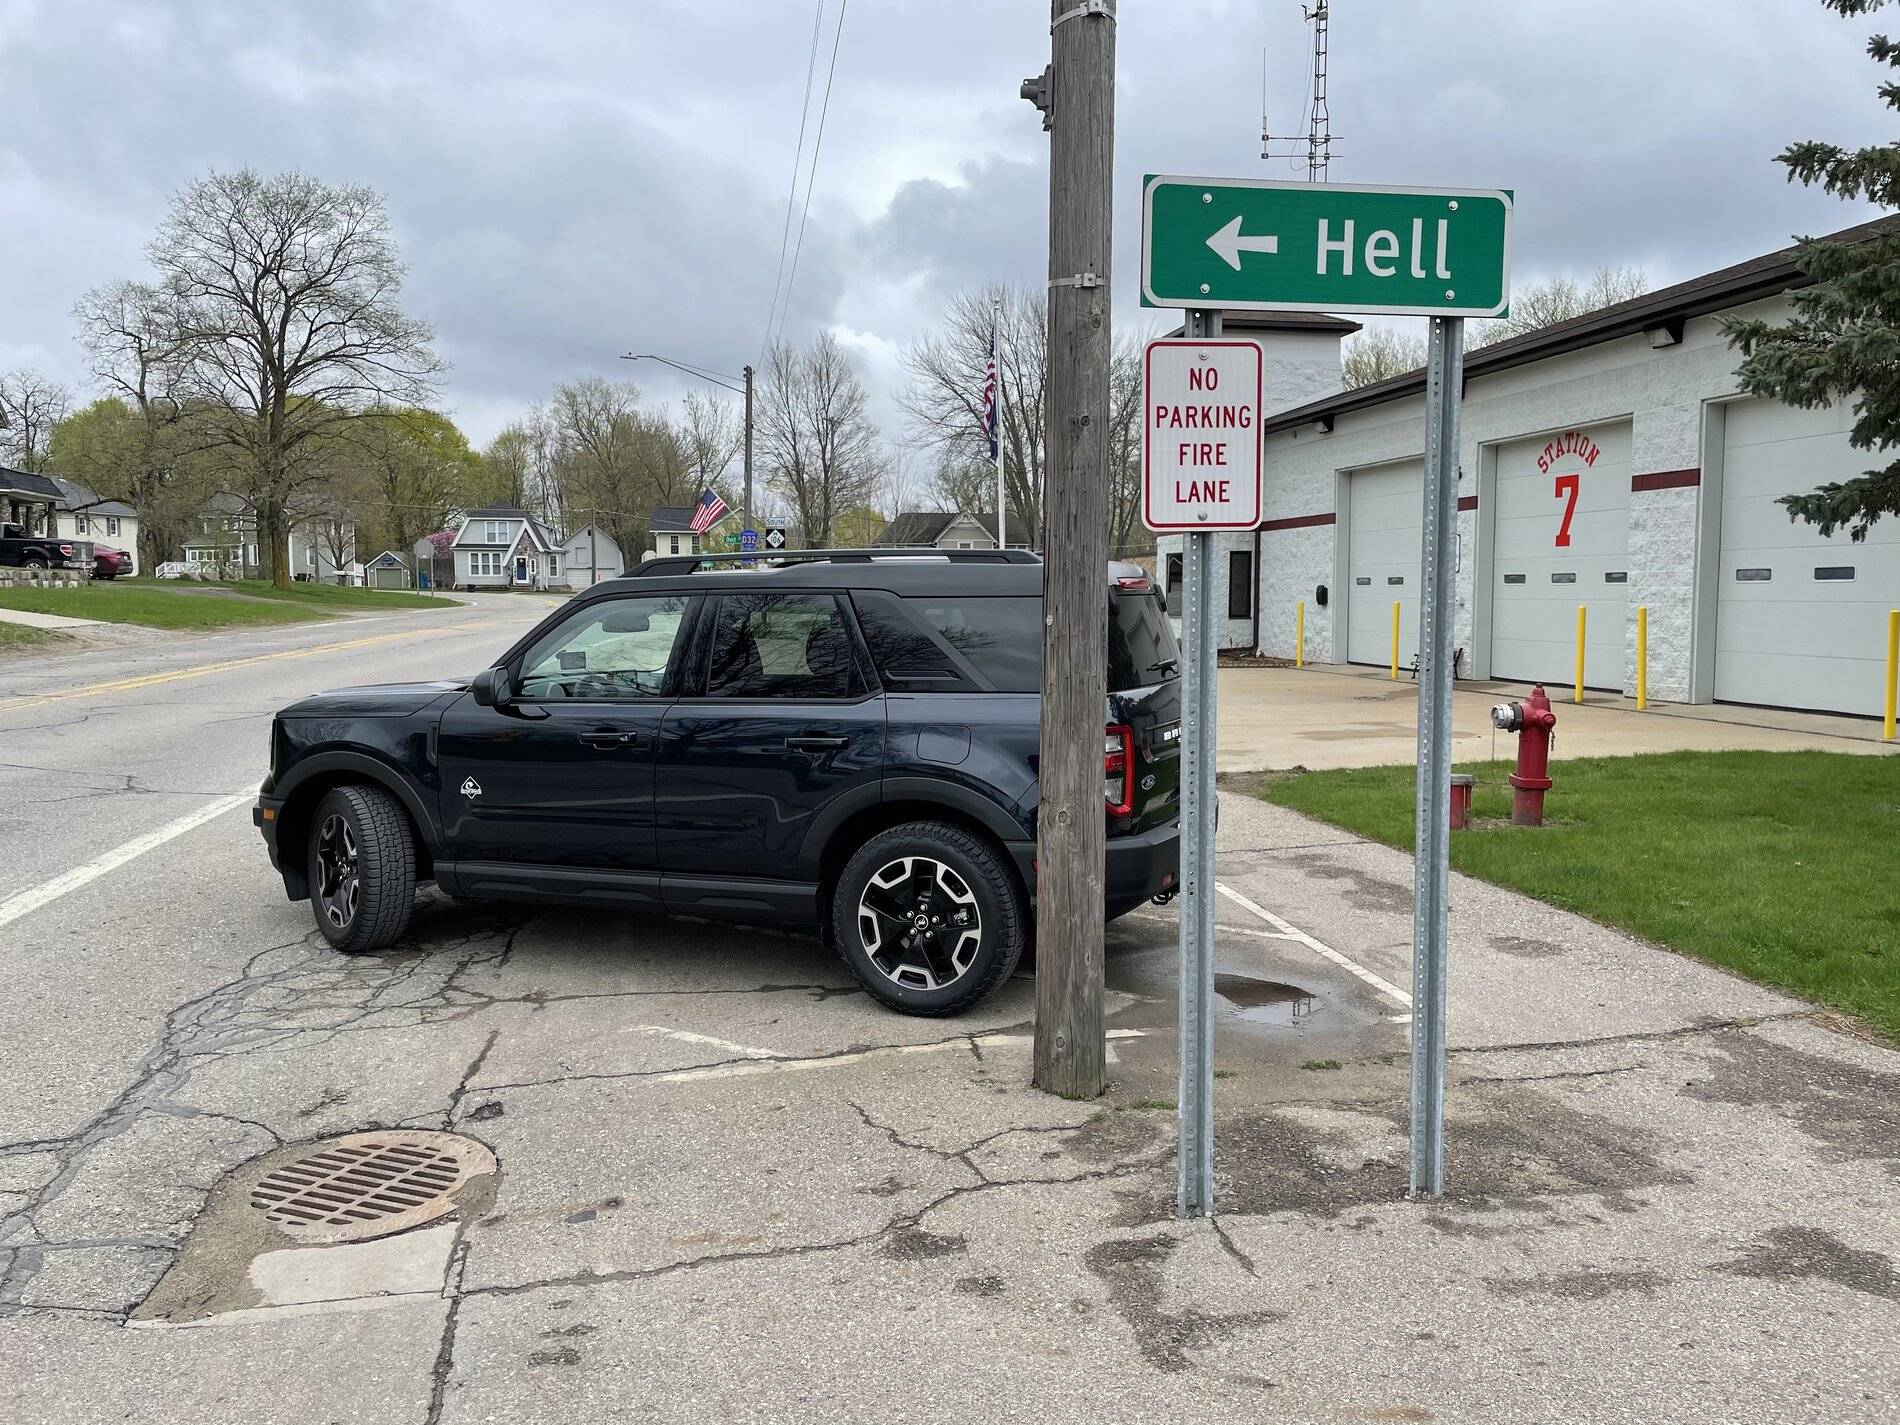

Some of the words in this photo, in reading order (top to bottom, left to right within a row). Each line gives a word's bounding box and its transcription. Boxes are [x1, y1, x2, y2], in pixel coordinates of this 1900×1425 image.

[1316, 218, 1451, 279] Hell
[1189, 367, 1219, 391] NO
[1156, 405, 1252, 429] PARKING
[1179, 443, 1228, 466] FIRE
[1536, 431, 1601, 474] STATION
[1175, 480, 1230, 503] LANE
[767, 518, 784, 526] SOUTH
[1554, 474, 1580, 547] 7
[742, 535, 756, 544] D32
[770, 536, 781, 544] 106
